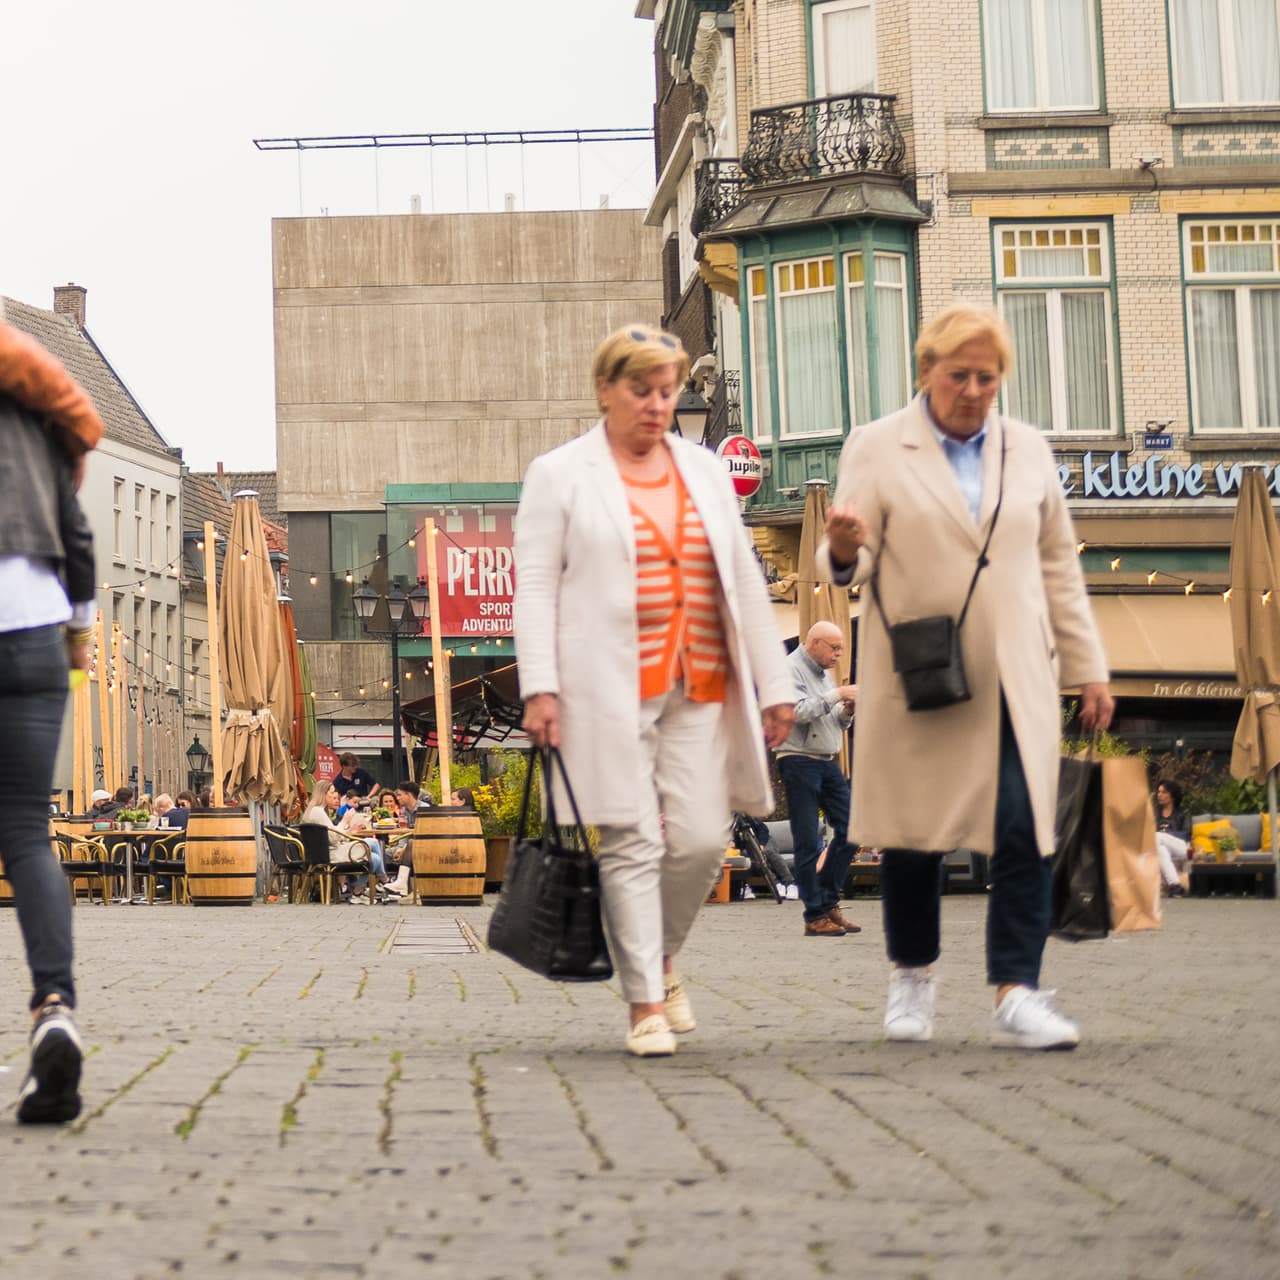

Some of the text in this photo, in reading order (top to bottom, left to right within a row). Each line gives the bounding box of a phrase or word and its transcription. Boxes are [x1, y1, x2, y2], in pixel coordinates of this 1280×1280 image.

[1145, 438, 1170, 446] MARKT
[1083, 450, 1207, 498] kleine
[1153, 683, 1169, 696] In
[1174, 682, 1192, 696] de
[1196, 682, 1242, 697] kleine
